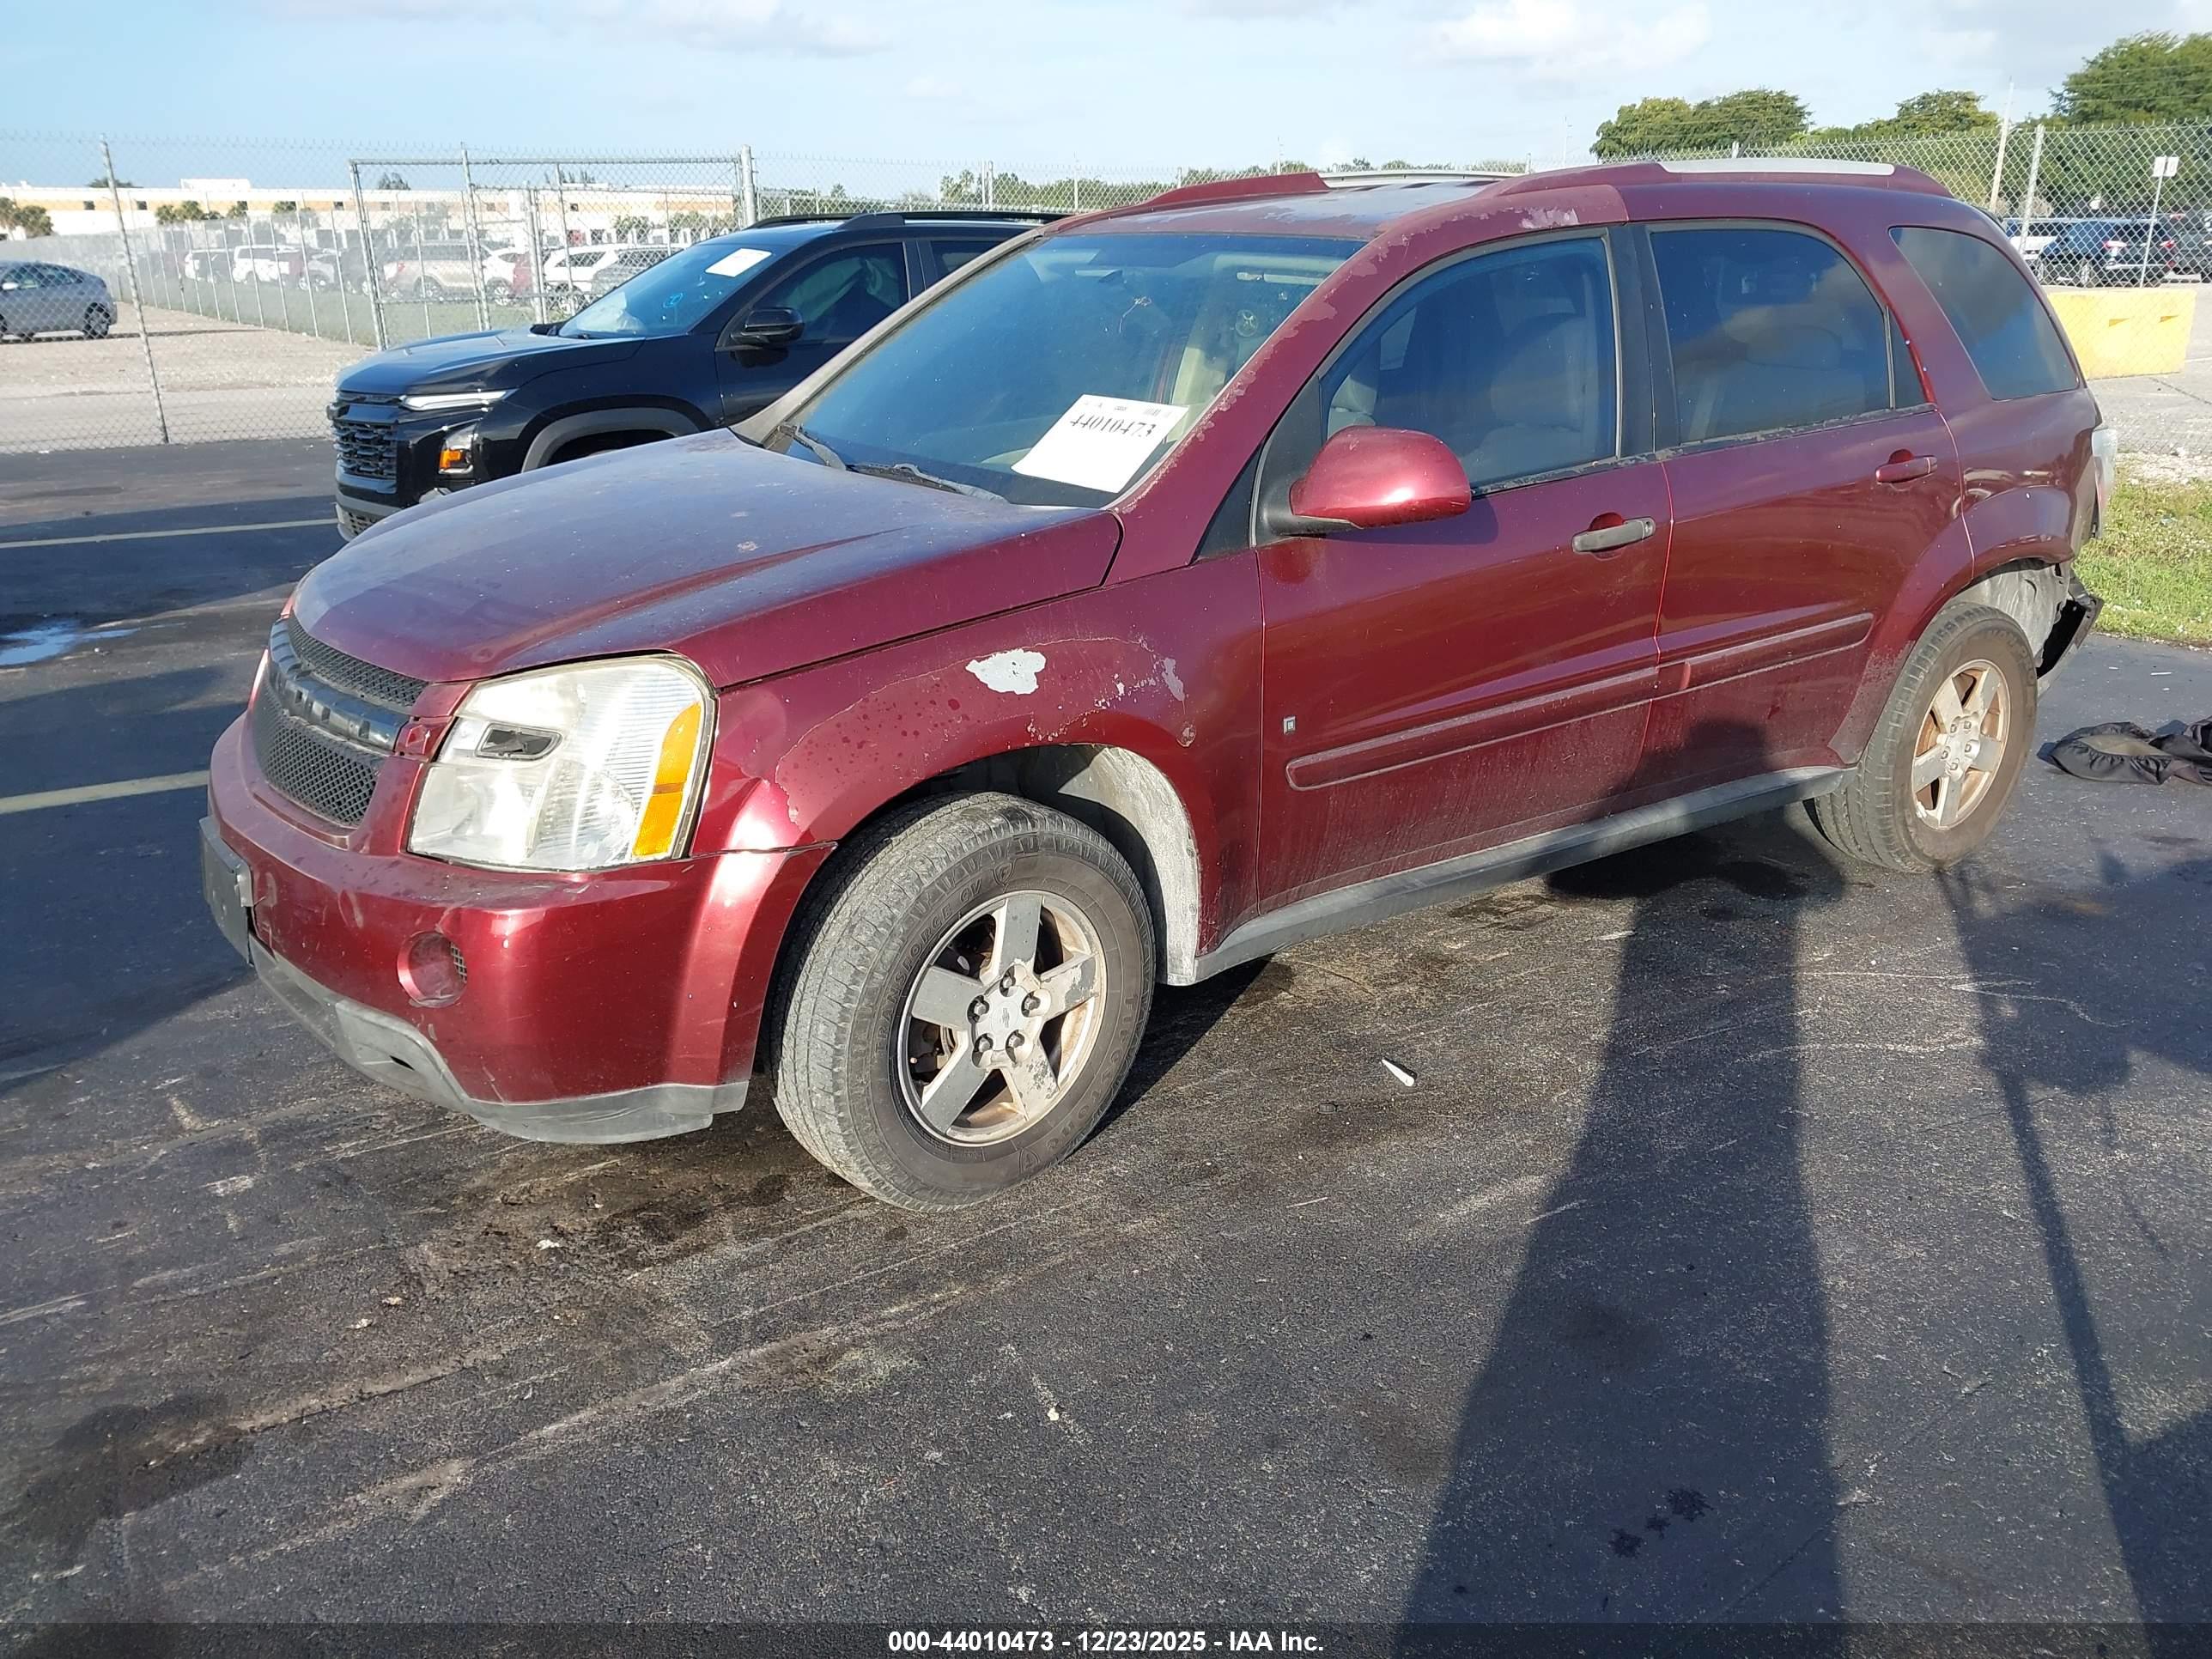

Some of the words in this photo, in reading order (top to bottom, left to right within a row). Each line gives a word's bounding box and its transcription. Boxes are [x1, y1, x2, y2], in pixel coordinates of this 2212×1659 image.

[1070, 414, 1157, 438] 44010473
[877, 904, 953, 1054] TRANSFORCE
[959, 878, 982, 902] CV
[1046, 996, 1136, 1150] Firestone
